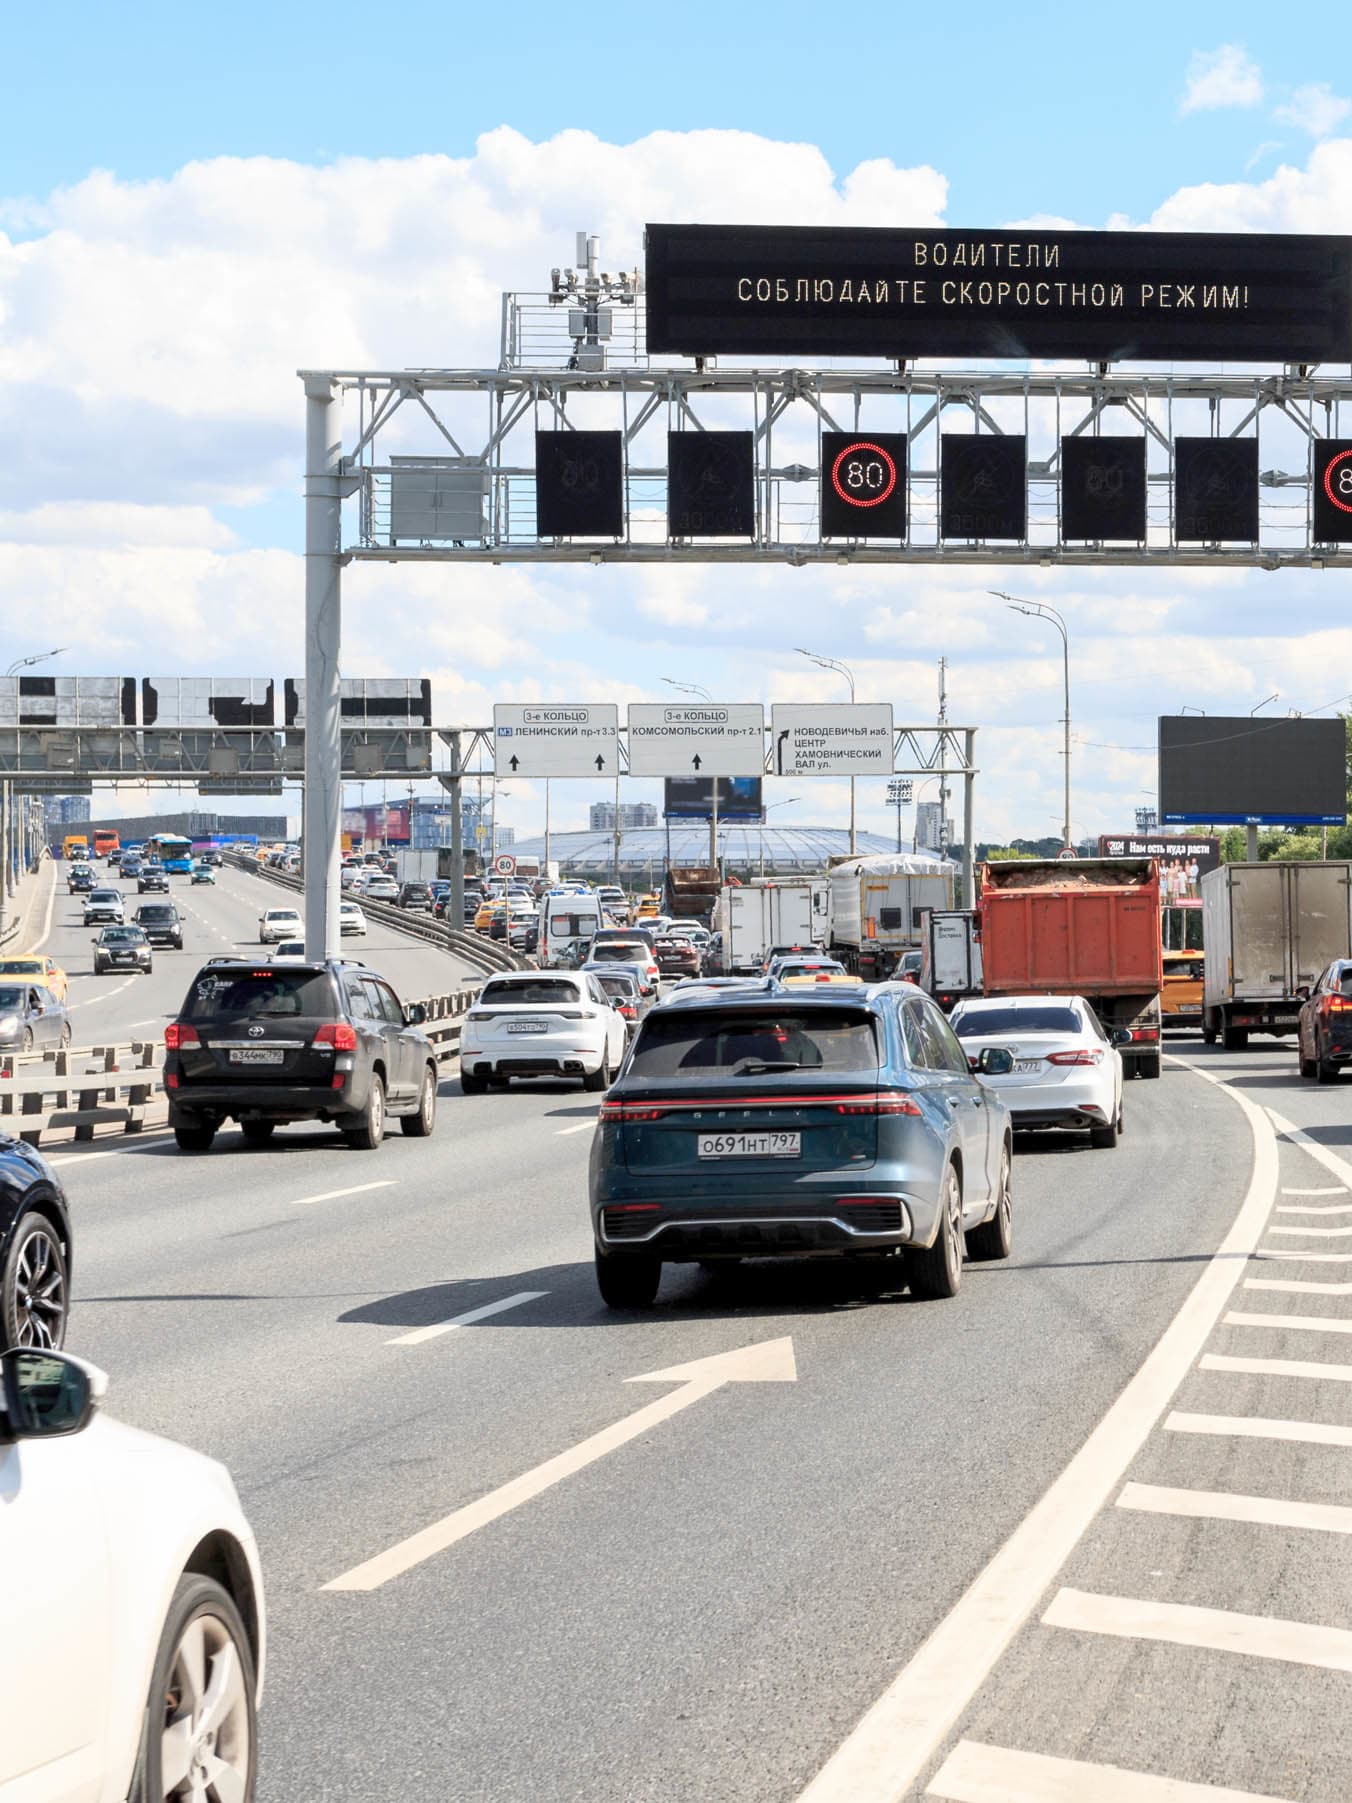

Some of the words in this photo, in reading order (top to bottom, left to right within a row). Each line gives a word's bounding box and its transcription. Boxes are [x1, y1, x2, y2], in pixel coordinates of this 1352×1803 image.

[913, 242, 1061, 268] ВОДИТЕЛИ
[737, 277, 927, 304] СОБЛЮДАЙТЕ
[941, 281, 1124, 307] СКОРОСТНОЙ
[1140, 285, 1250, 309] РЕЖИМ!
[847, 461, 883, 488] 80
[543, 712, 587, 721] КОЛЬЦО
[684, 712, 726, 721] КОЛЬЦО
[516, 726, 578, 736] ЛЕНИНСКИЙ
[581, 729, 600, 738] пр-т
[632, 726, 725, 736] КОМСОМОЛЬСКИЙ
[727, 729, 747, 737] пр-т
[794, 727, 867, 737] НОВОДЕВИЧЬЯ
[870, 727, 889, 736] наб.
[795, 739, 826, 748] ЦЕНТР
[795, 748, 882, 758] ХАМОВНИЧЕСКИЙ
[795, 760, 815, 768] ВАЛ
[817, 761, 831, 770] ул.
[1129, 841, 1146, 853] Нам
[499, 861, 511, 870] 80
